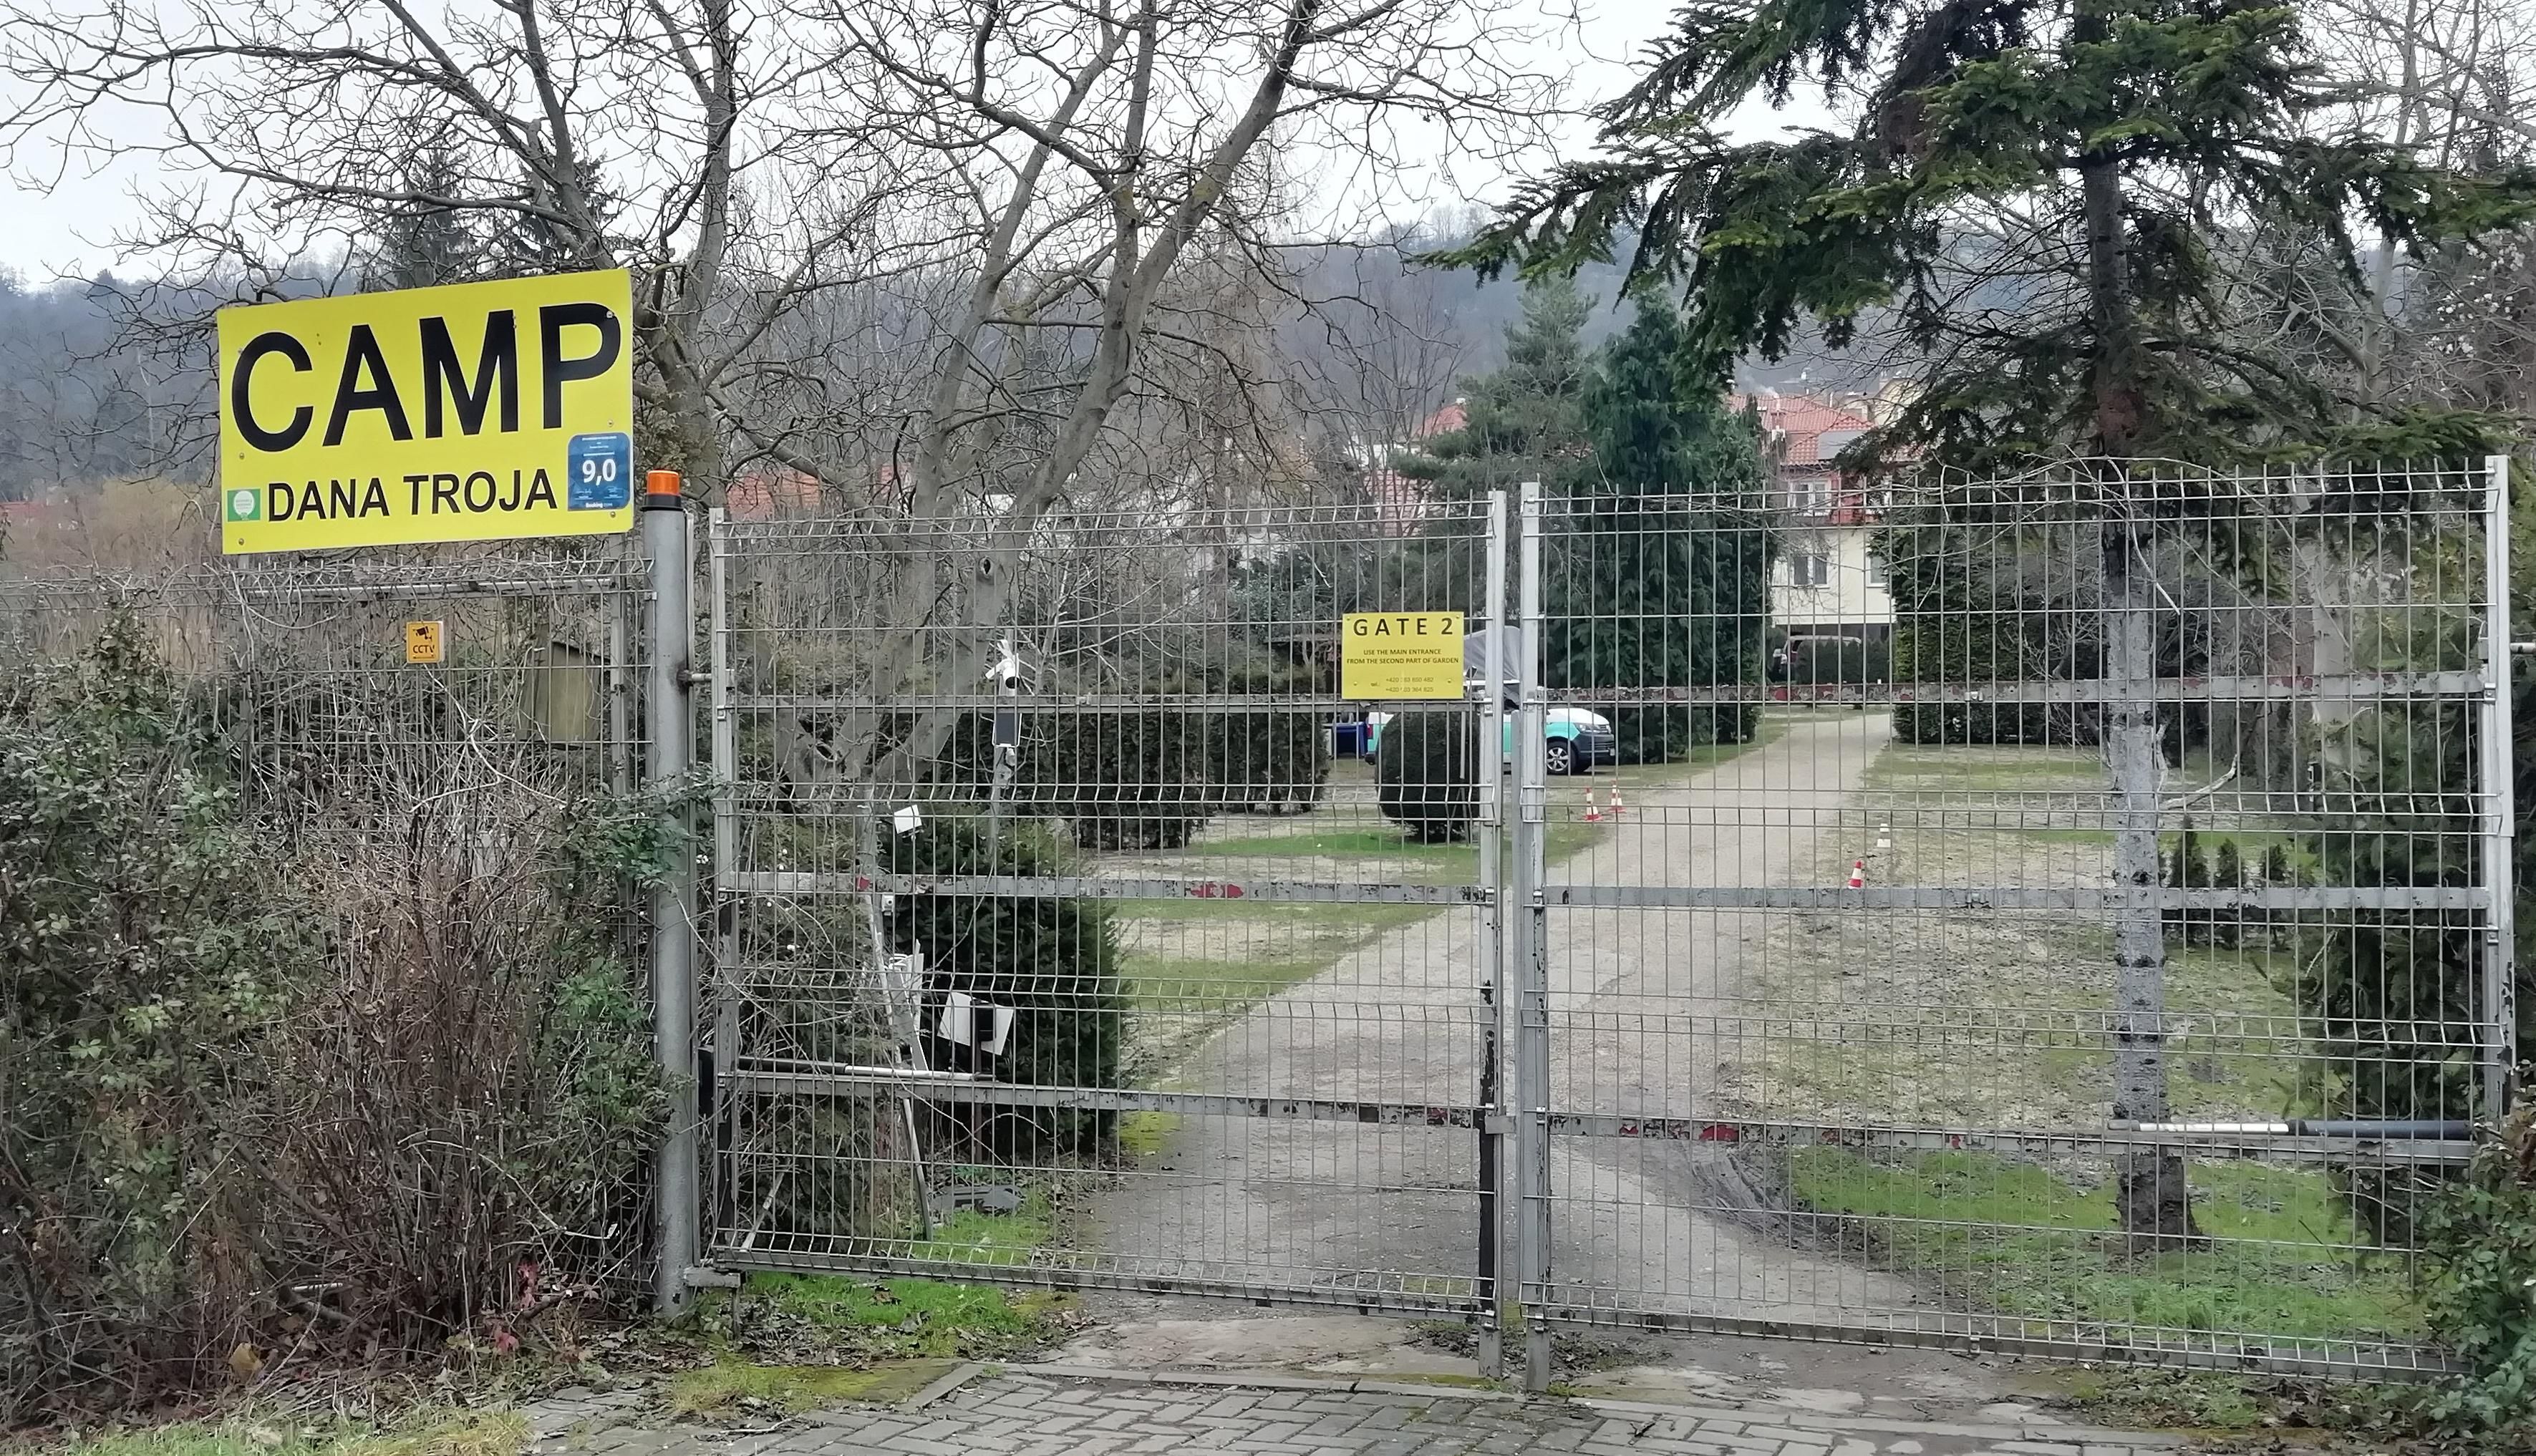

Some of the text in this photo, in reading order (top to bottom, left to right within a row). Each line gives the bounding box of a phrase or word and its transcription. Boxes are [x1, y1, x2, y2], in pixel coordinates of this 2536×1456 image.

[232, 303, 621, 452] CAMP
[582, 459, 616, 485] 9,0
[268, 468, 557, 523] DANA TROJA
[1353, 617, 1453, 636] GATE 2
[412, 644, 435, 654] CCTV
